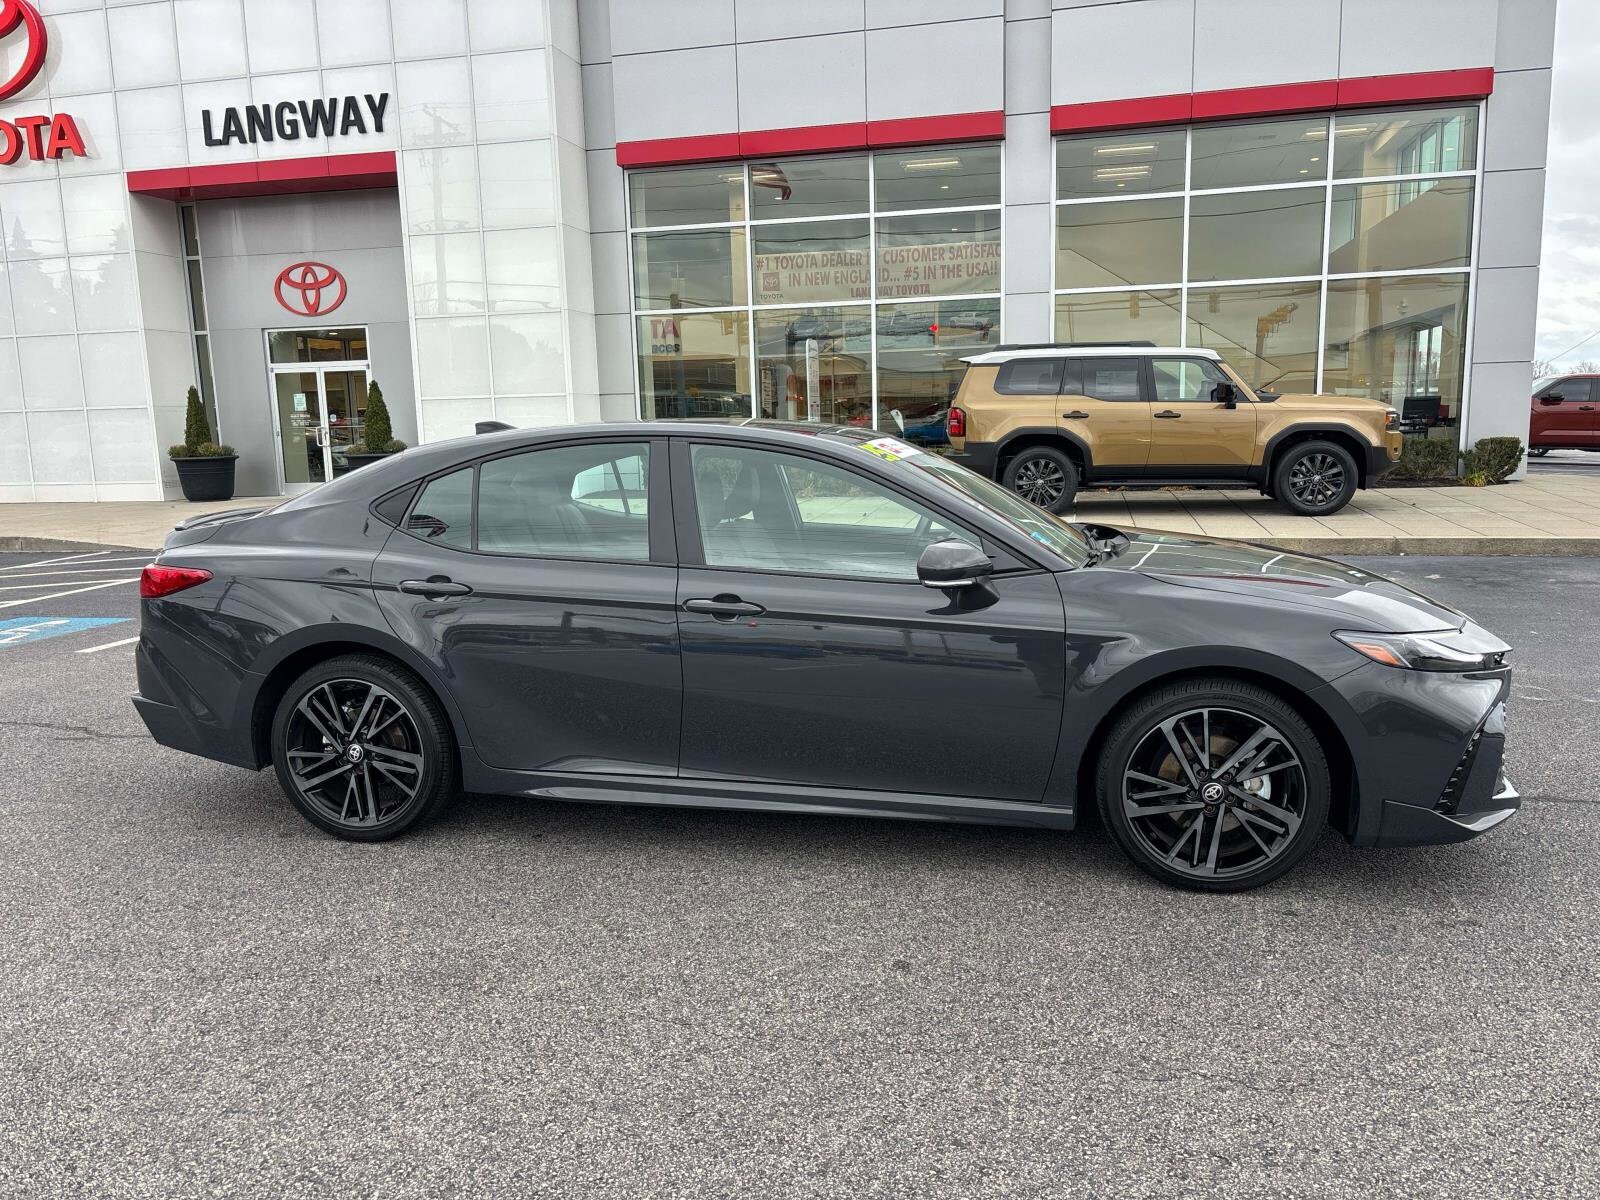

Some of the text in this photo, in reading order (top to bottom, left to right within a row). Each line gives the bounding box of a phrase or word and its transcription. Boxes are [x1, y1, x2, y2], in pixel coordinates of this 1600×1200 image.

[202, 92, 389, 147] LANGWAY
[756, 255, 770, 271] #1
[774, 254, 818, 270] TOYOTA
[821, 252, 863, 267] DEALER
[883, 247, 946, 264] CUSTOMER
[788, 272, 801, 287] IN
[805, 271, 830, 286] NEW
[904, 266, 920, 281] #5
[923, 265, 937, 280] IN
[940, 264, 962, 279] THE
[966, 261, 997, 277] USA!!
[896, 284, 931, 295] TOYOTA
